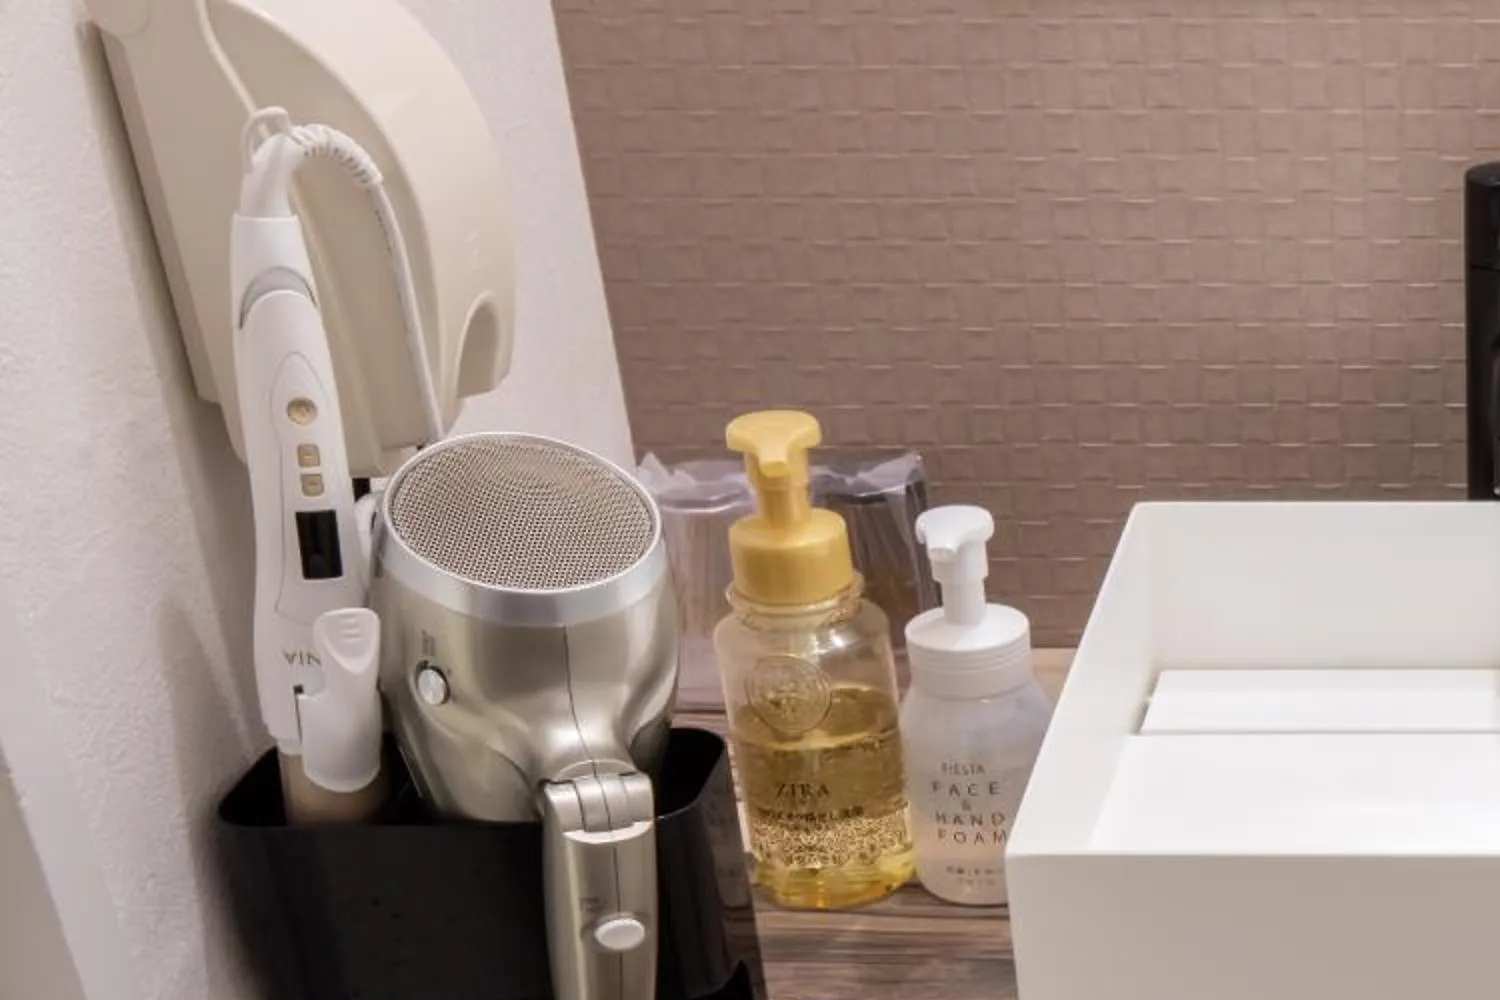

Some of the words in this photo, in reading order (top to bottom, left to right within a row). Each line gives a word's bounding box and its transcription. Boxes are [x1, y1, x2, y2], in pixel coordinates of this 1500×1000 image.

[931, 781, 1001, 798] FACE
[936, 810, 1006, 827] HAND
[937, 828, 1007, 845] FOAM
